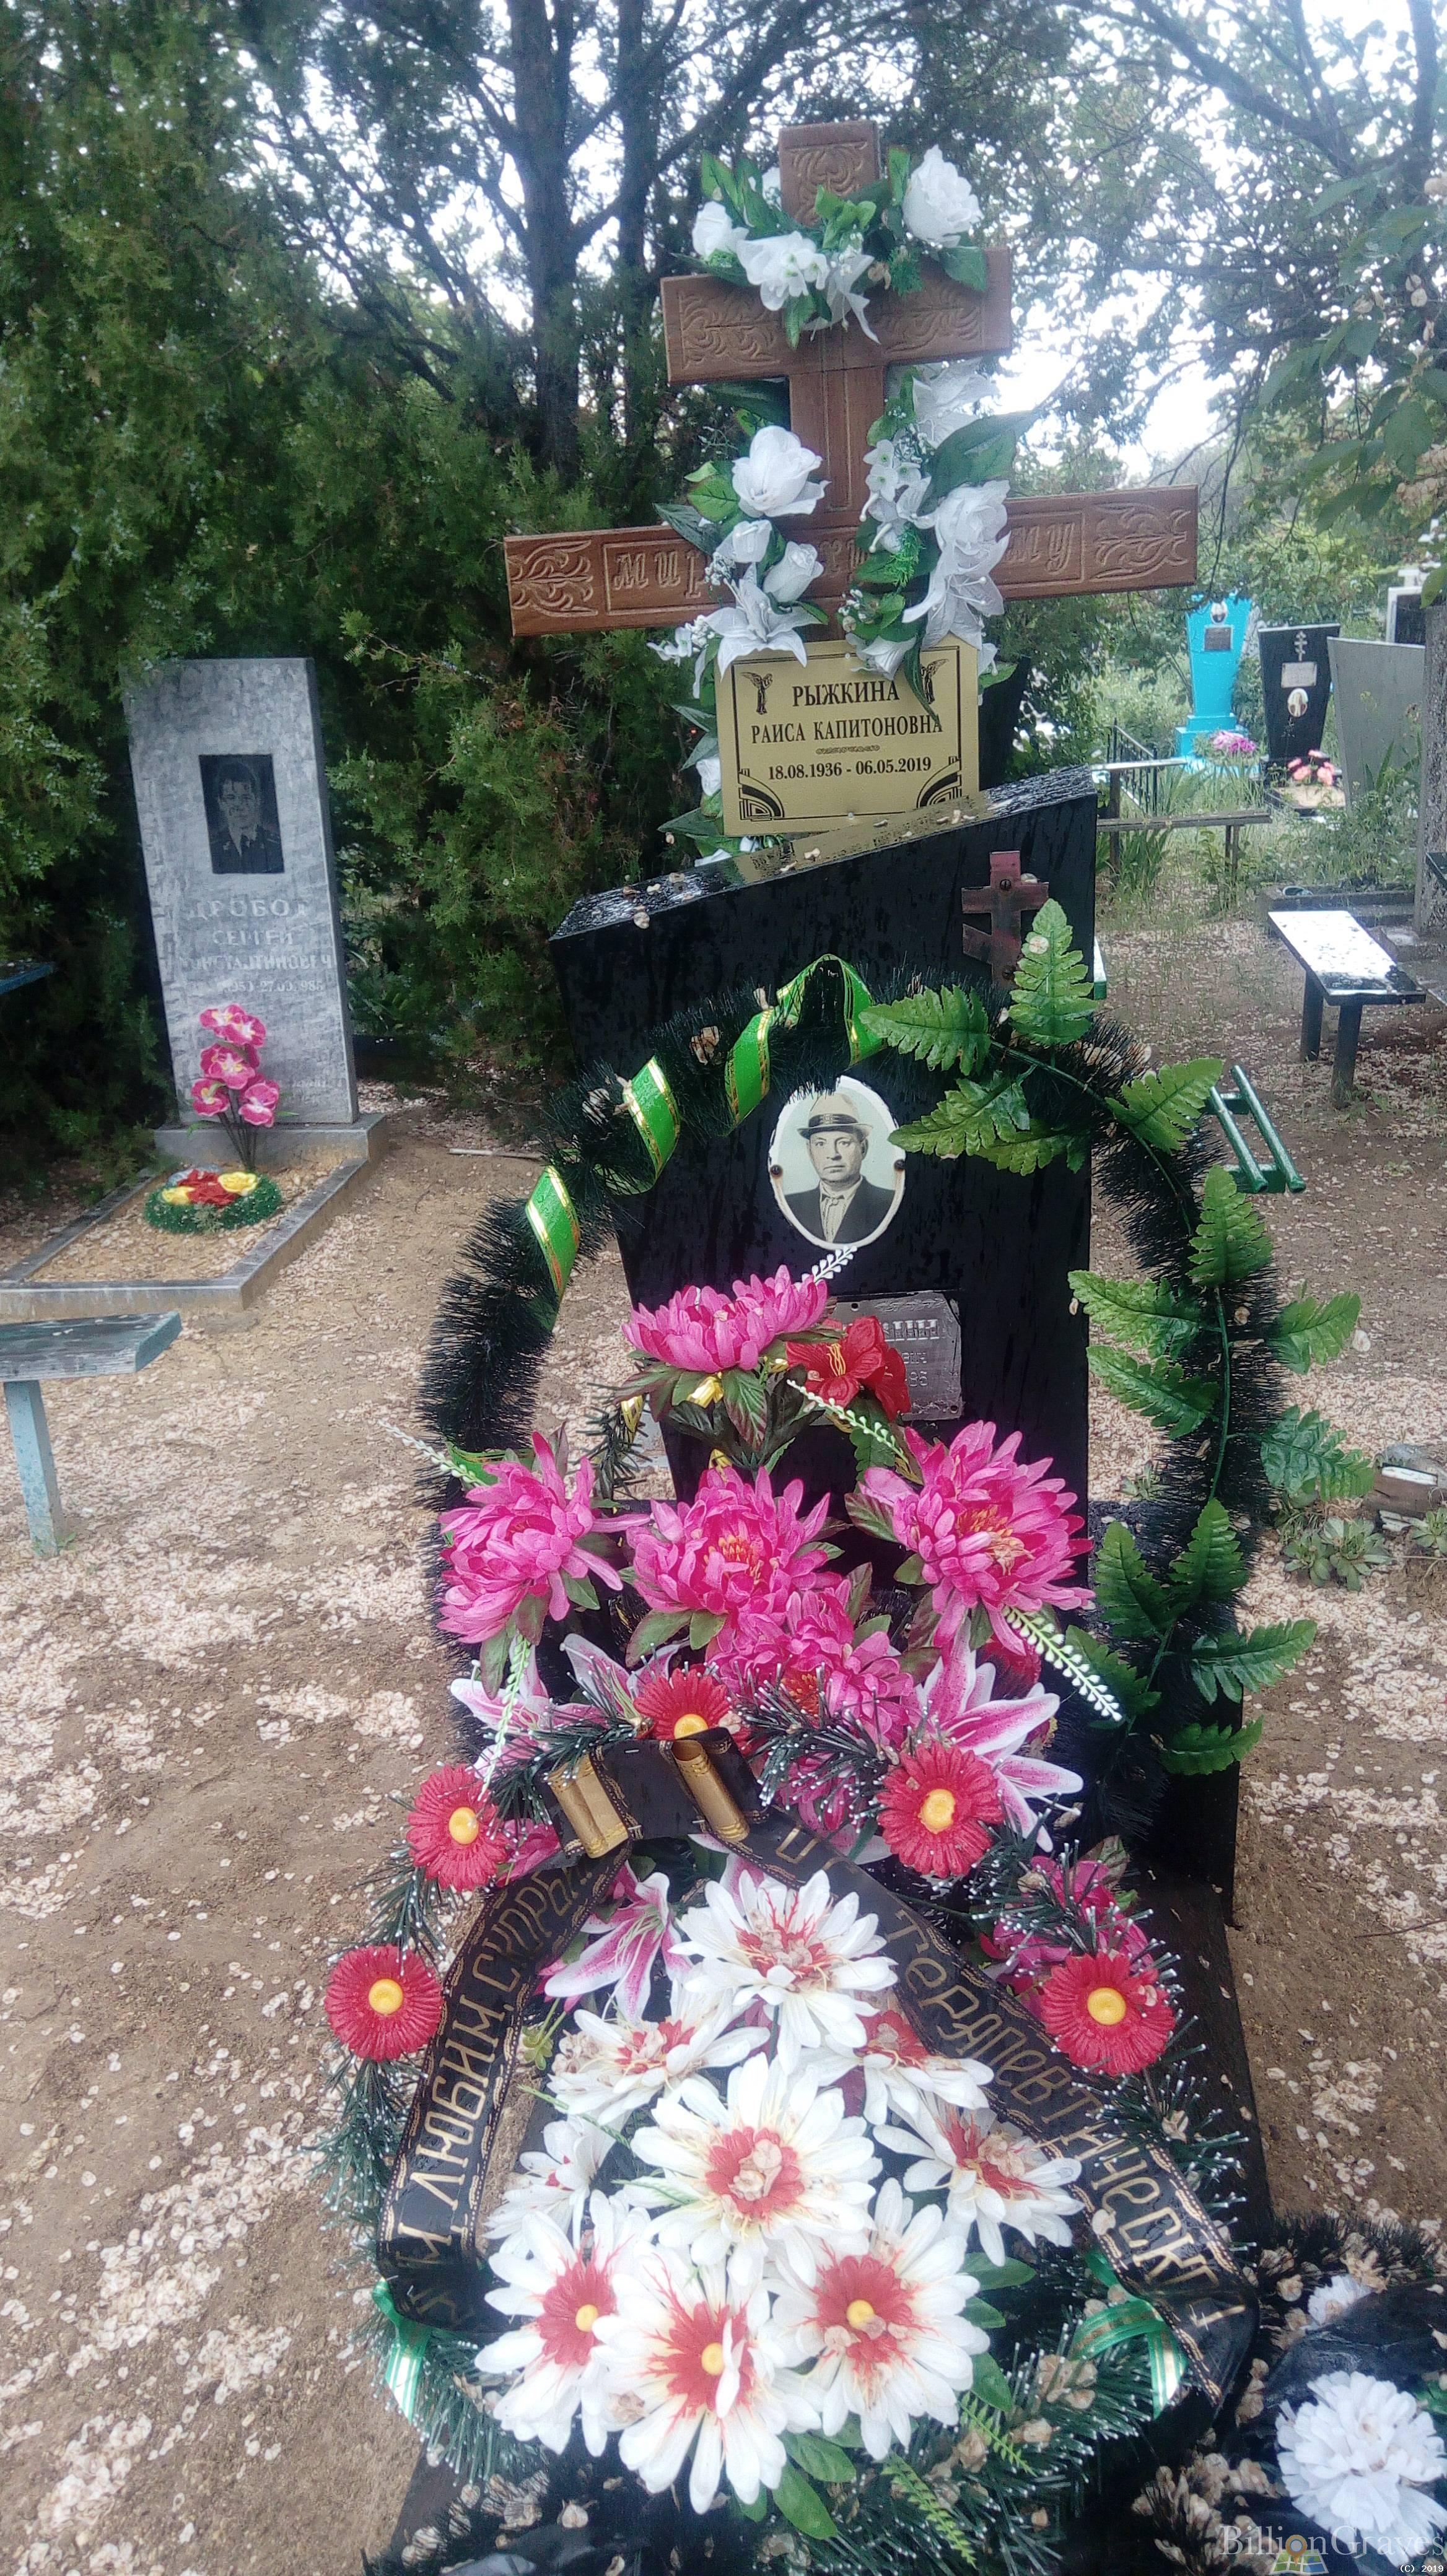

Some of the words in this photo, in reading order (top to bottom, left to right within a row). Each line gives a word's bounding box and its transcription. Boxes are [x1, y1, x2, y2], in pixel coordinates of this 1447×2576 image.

[792, 681, 900, 707] РЫЖКИНА
[751, 722, 806, 744] РАИСА
[814, 715, 943, 740] КАПИТОНОВНА
[769, 761, 842, 780] 18.08.1936
[855, 757, 932, 776] 06.05.2019
